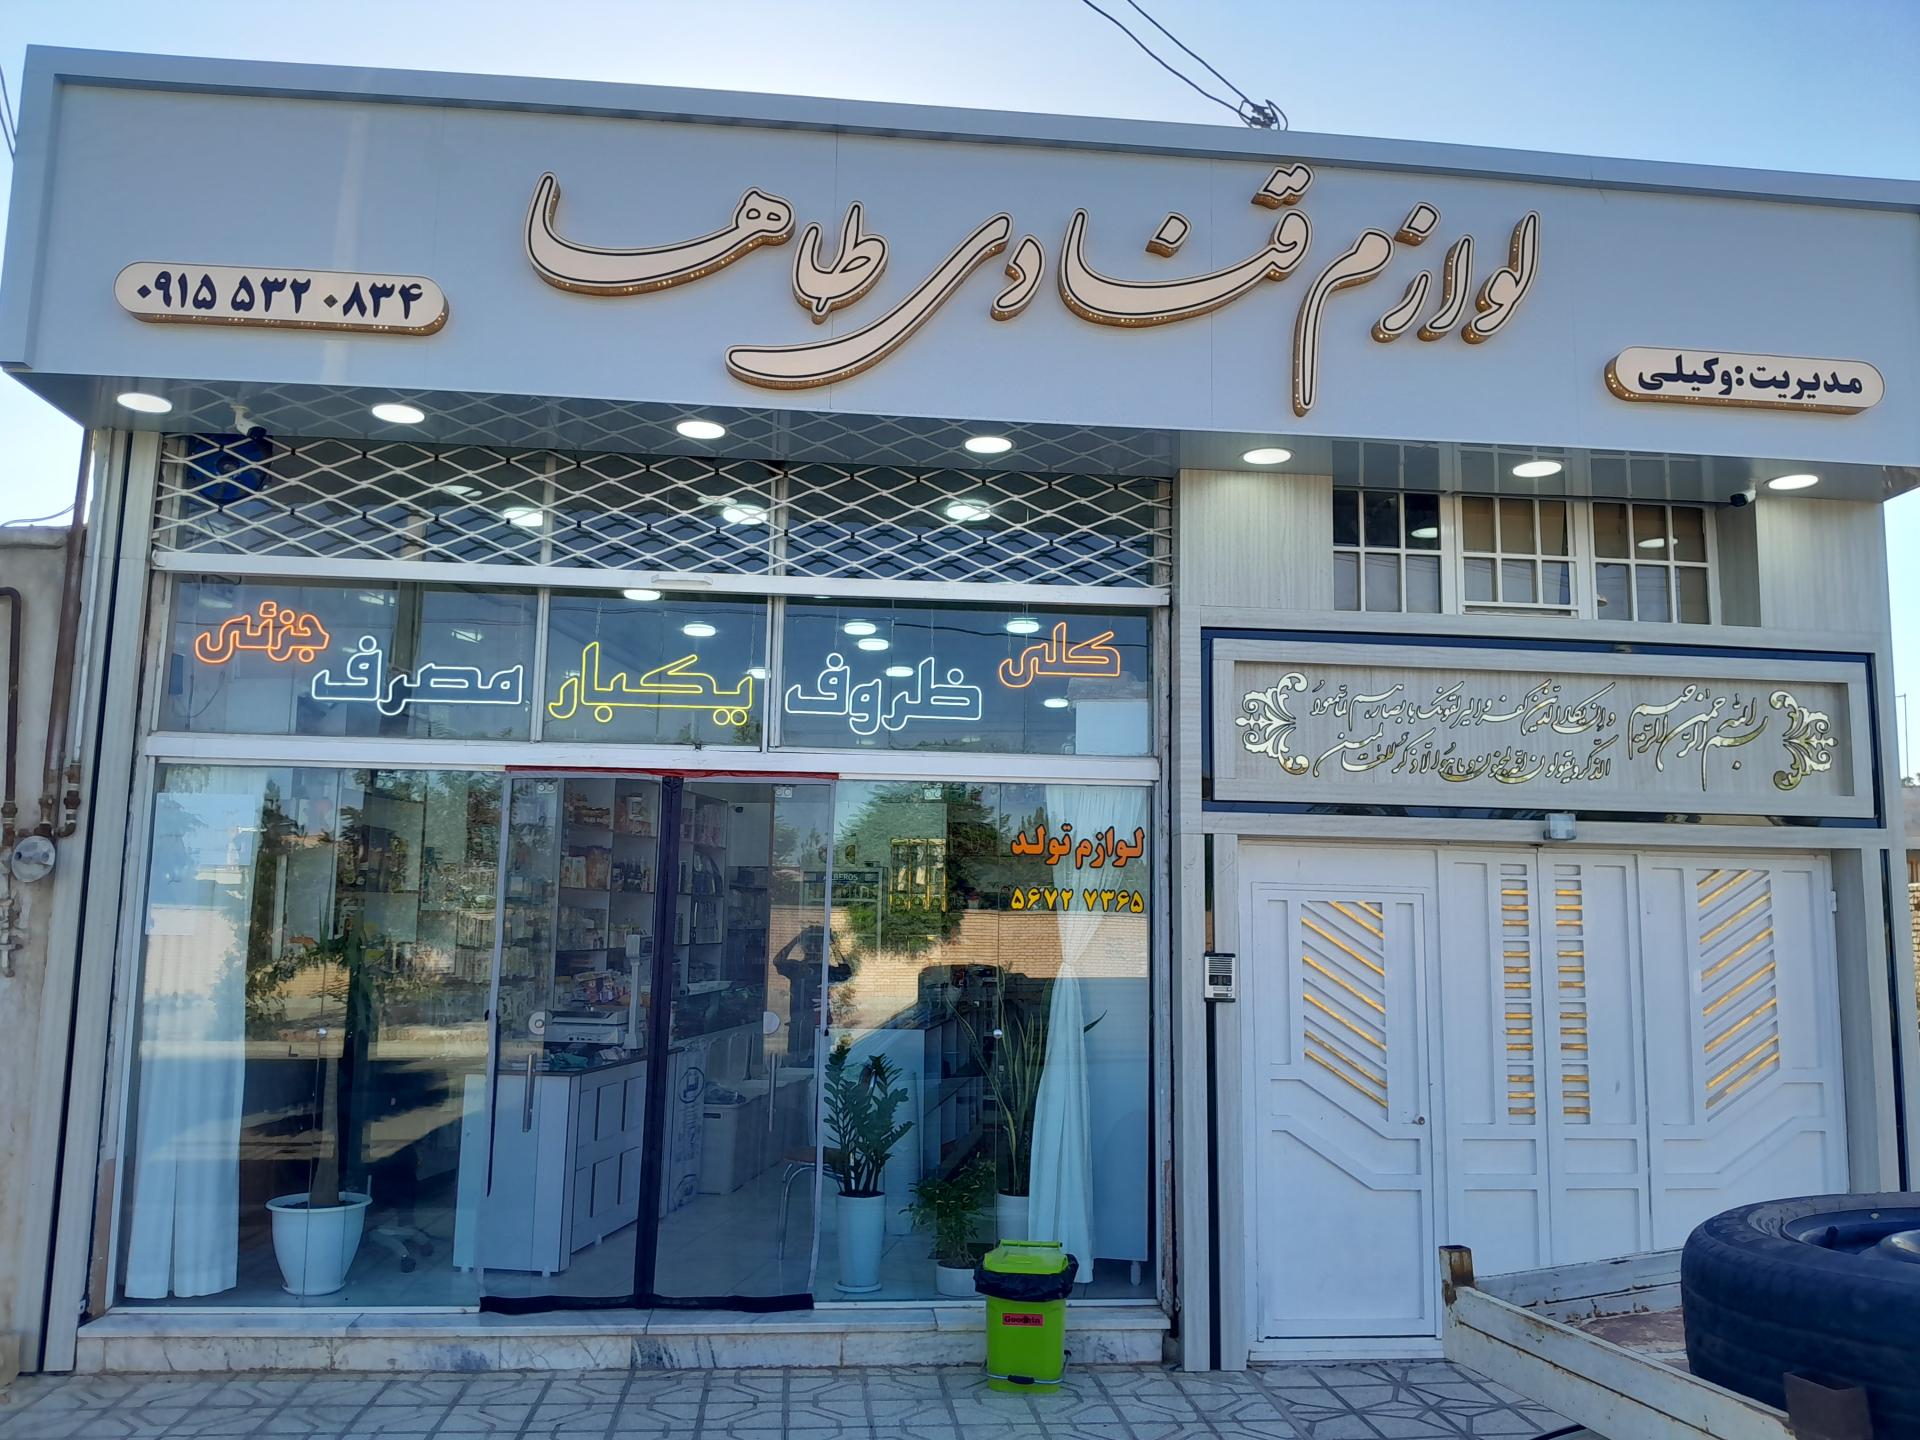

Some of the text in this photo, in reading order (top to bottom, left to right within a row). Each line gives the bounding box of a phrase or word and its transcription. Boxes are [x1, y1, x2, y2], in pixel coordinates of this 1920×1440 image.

[136, 270, 424, 320] ۰۹۱۵ ۵۳۲ ۰۸۳۴
[725, 162, 1315, 391] قنادی
[1293, 202, 1542, 416] لوازم
[311, 635, 983, 737] ظروف یکبار مصرف
[998, 621, 1121, 688] کلی
[1010, 822, 1146, 869] لوازم تولد
[1010, 886, 1145, 914] ۵۶۷۲ ۷۳۶۵
